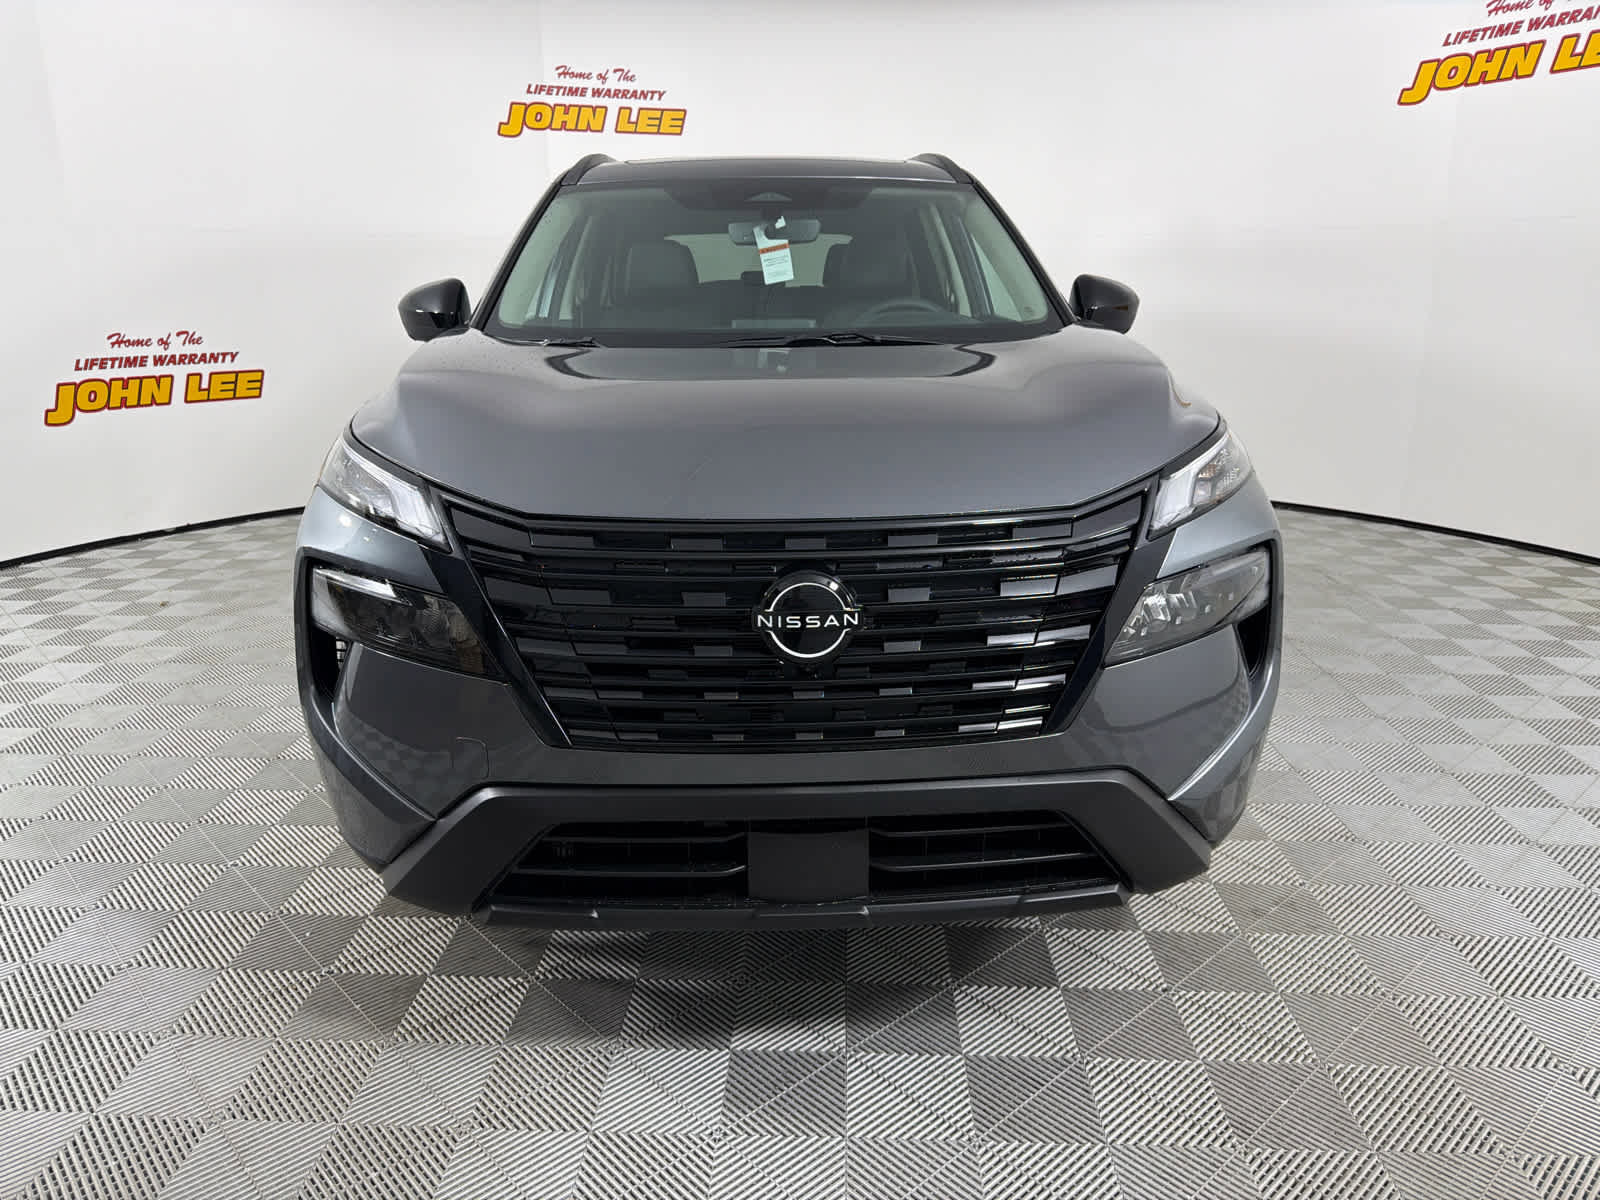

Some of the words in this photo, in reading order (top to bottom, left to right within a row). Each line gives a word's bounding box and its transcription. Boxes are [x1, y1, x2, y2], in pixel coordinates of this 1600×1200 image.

[1486, 0, 1533, 16] Home
[1442, 19, 1525, 47] LIFETIME
[555, 65, 593, 80] Home
[596, 69, 609, 84] of
[612, 68, 636, 82] The
[1397, 39, 1547, 105] JOHN
[526, 83, 588, 98] LIFETIME
[591, 87, 667, 101] WARRANTY
[498, 101, 608, 138] JOHN
[615, 106, 687, 136] LEE
[106, 332, 152, 349] Home
[156, 333, 171, 351] of
[175, 330, 204, 346] The
[74, 355, 149, 371] LIFETIME
[152, 351, 240, 368] WARRANTY
[44, 374, 174, 427] JOHN
[184, 369, 265, 404] LEE
[757, 612, 858, 628] NISSAN
